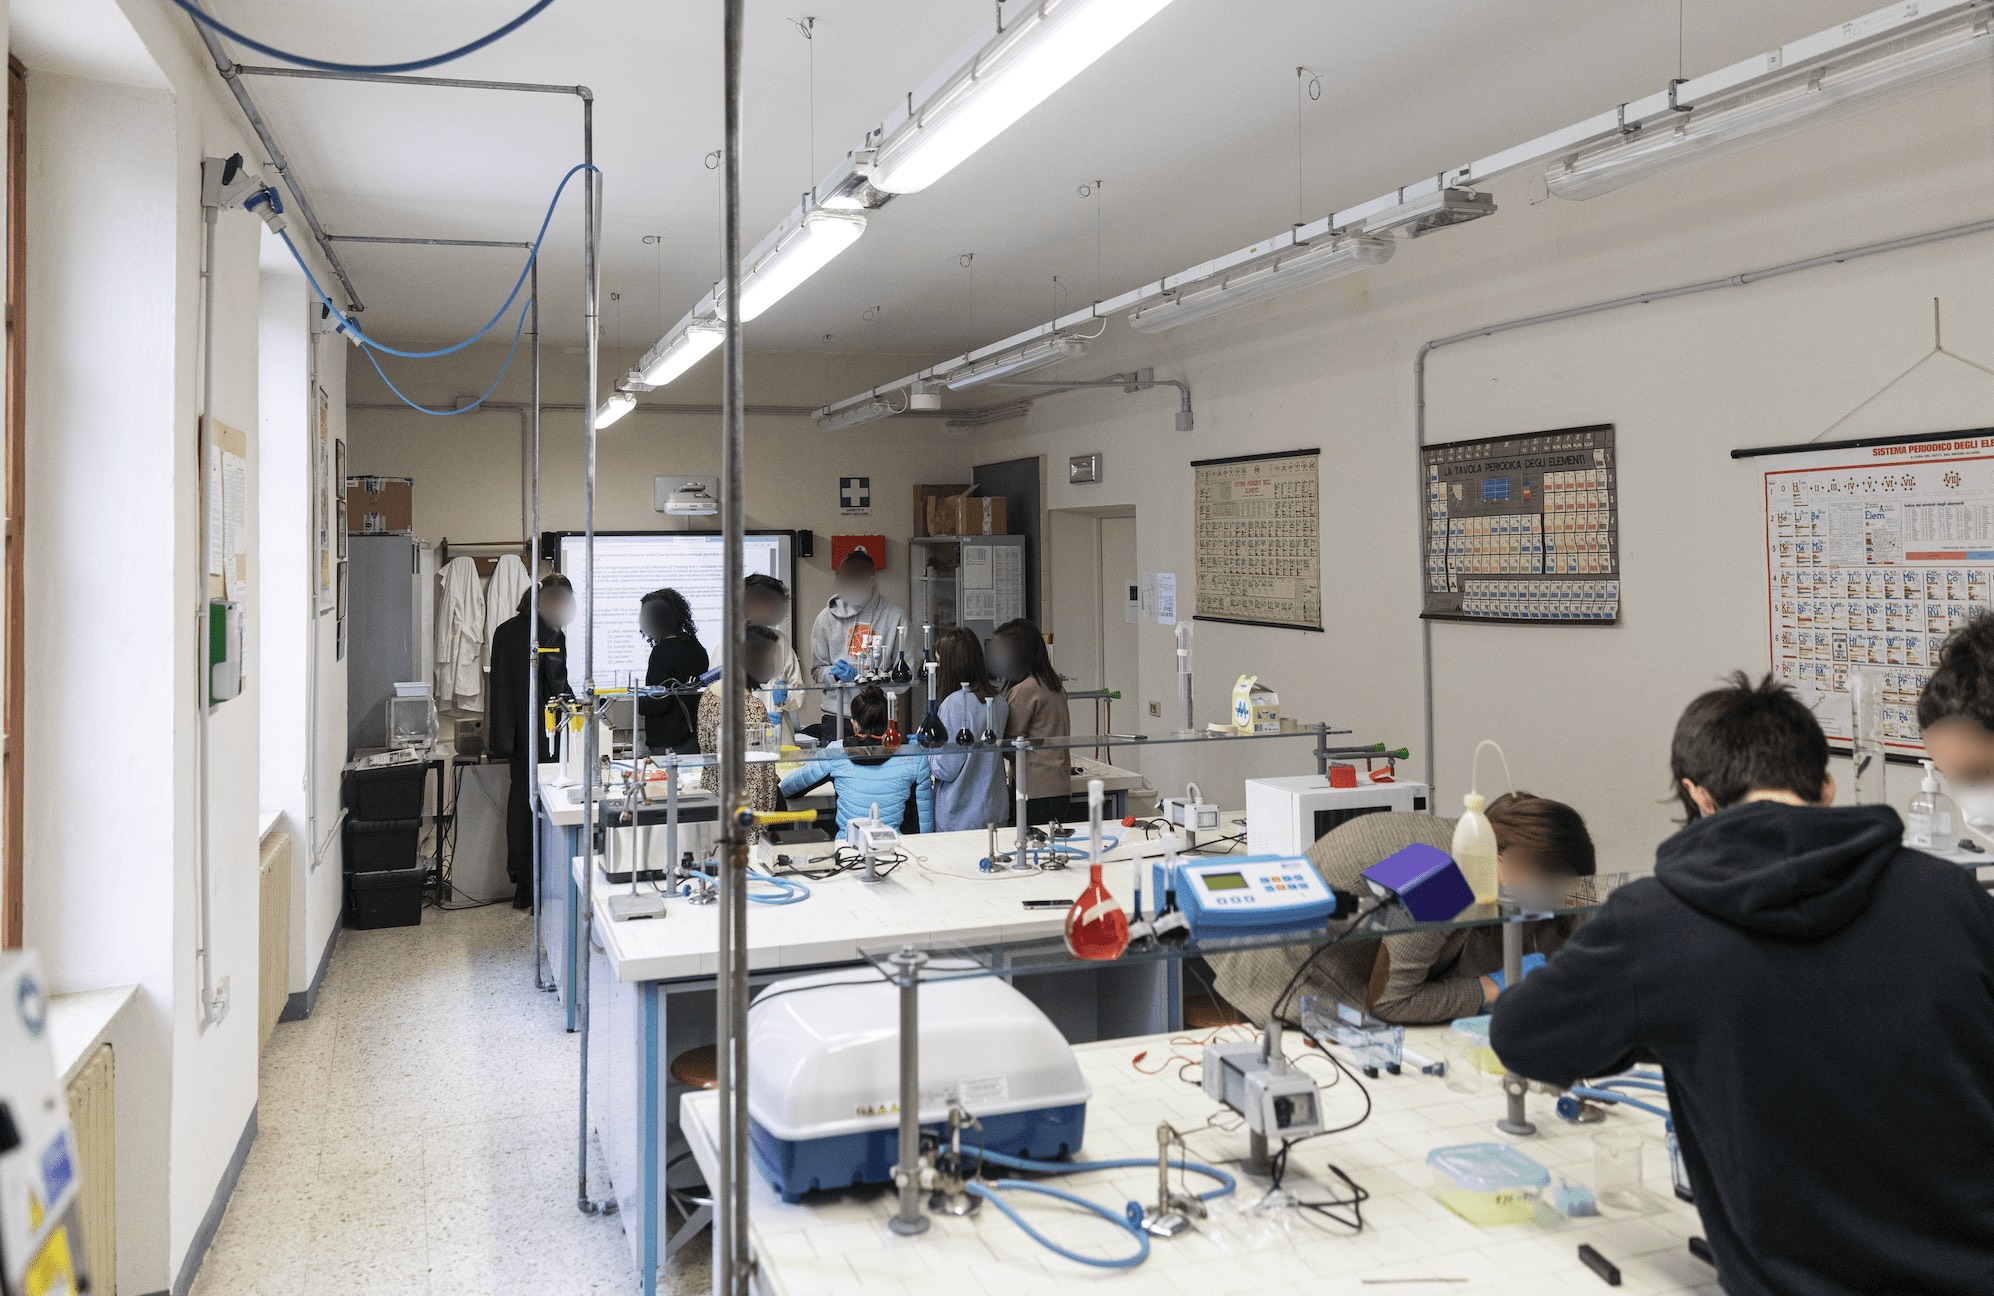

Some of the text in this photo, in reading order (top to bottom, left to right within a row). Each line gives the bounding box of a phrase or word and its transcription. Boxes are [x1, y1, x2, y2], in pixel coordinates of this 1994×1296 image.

[1872, 446, 1906, 456] SISTEMA
[1908, 443, 1952, 454] PERIODICO
[1954, 440, 1978, 450] DEGLI
[1444, 454, 1585, 477] LA TAVOLA PERIODICA DEGLI ELEMENTI
[1945, 476, 1959, 484] VIII
[1778, 513, 1787, 522] He
[1795, 512, 1802, 521] Li
[1811, 512, 1820, 520] Be
[1865, 511, 1885, 520] Elem
[1780, 543, 1788, 552] Ne
[1796, 544, 1804, 552] Na
[1812, 543, 1822, 552] Mg
[1781, 575, 1789, 583] Ar
[1812, 574, 1822, 582] Ca
[1830, 574, 1838, 582] Sc
[1866, 573, 1871, 582] V
[1884, 573, 1894, 582] Cr
[1903, 573, 1915, 582] Mn
[1926, 574, 1936, 582] Fe
[1946, 573, 1958, 582] Co
[1968, 573, 1978, 582] Ni
[1797, 604, 1806, 612] Rb
[1831, 605, 1836, 613] Y
[1848, 606, 1857, 614] Zr
[1866, 606, 1878, 614] Nb
[1885, 606, 1897, 615] Mo
[1905, 606, 1913, 614] Tc
[1927, 606, 1939, 615] Ru
[1948, 607, 1960, 616] Rh
[1886, 638, 1895, 646] W
[1906, 639, 1916, 647] Re
[1799, 665, 1806, 673] Fr
[1898, 676, 1907, 685] Pr
[1916, 677, 1927, 686] Nd
[1899, 712, 1908, 721] Pa
